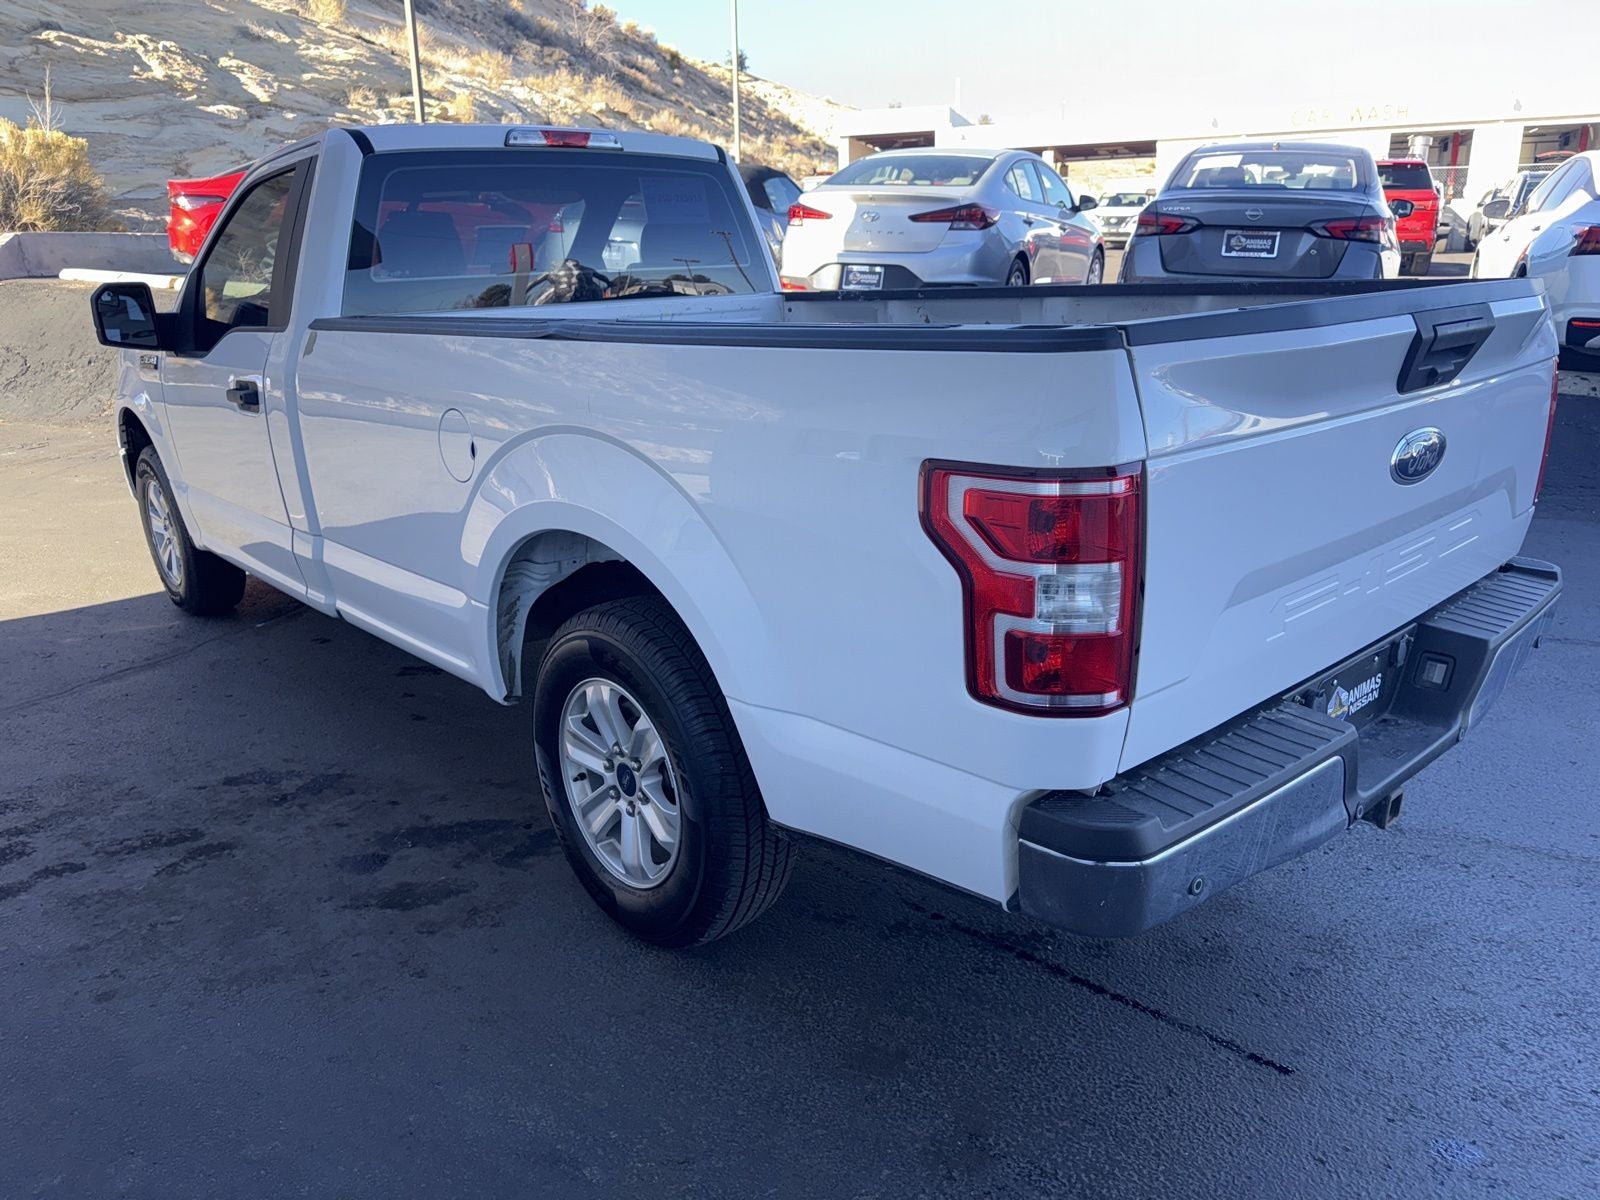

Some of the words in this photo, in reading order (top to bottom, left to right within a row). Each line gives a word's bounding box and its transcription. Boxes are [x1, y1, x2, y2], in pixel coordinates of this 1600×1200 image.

[1347, 104, 1409, 123] WASH
[1348, 673, 1382, 706] ANIMAS
[1349, 688, 1380, 716] NISSAN
